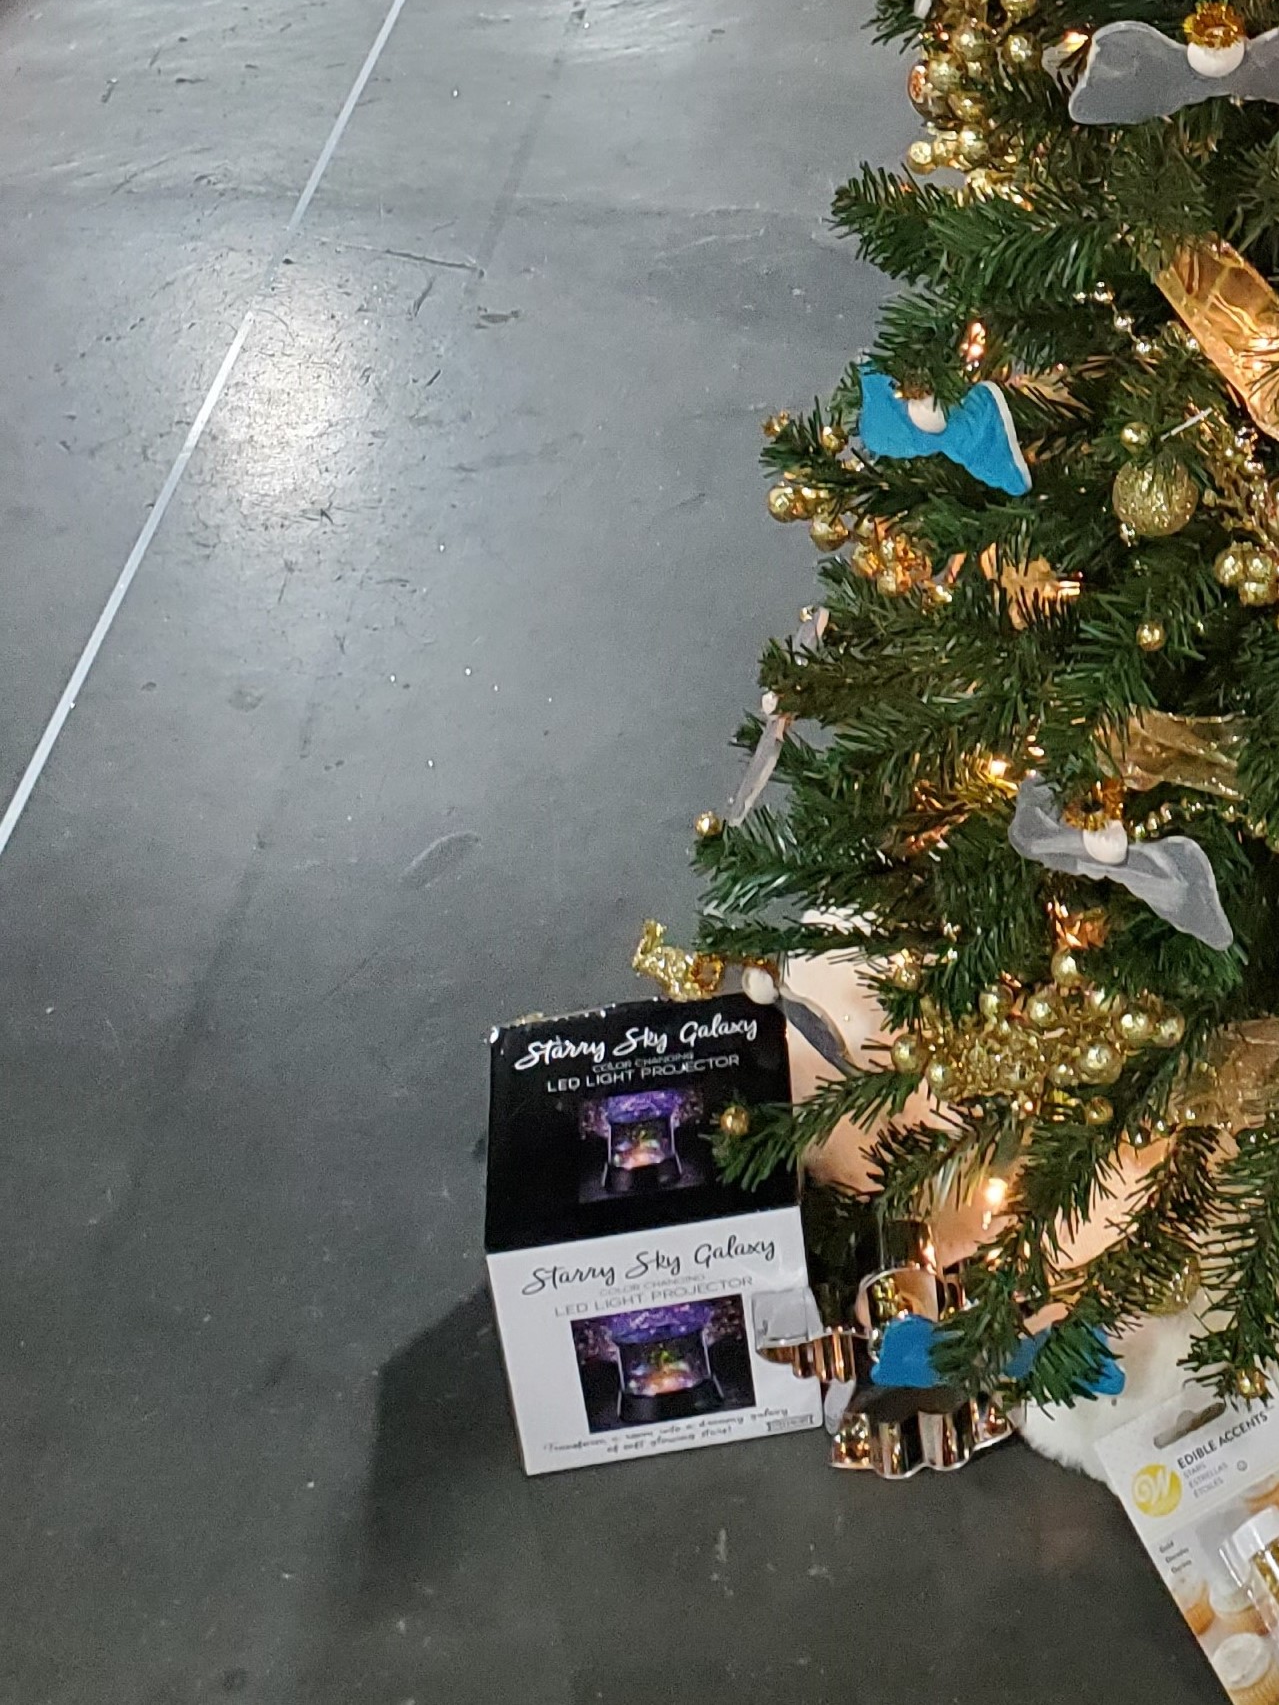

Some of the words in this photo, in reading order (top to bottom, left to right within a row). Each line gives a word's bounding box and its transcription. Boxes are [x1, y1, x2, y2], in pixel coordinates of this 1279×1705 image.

[514, 1035, 606, 1071] Starry
[612, 1027, 668, 1057] Sky
[679, 1013, 757, 1046] Galaxy
[592, 1060, 633, 1073] COLOR
[547, 1077, 581, 1093] LED
[586, 1070, 634, 1088] LIGHT
[640, 1054, 739, 1079] PROJECTOR
[522, 1265, 615, 1296] Starry
[625, 1250, 681, 1279] Sky
[694, 1234, 776, 1268] Galaxy
[554, 1303, 588, 1318] LED
[594, 1295, 643, 1311] LIGHT
[651, 1276, 753, 1302] PROJECTOR
[1177, 1439, 1217, 1469] EDIBLE
[1218, 1411, 1269, 1447] ACCENTS
